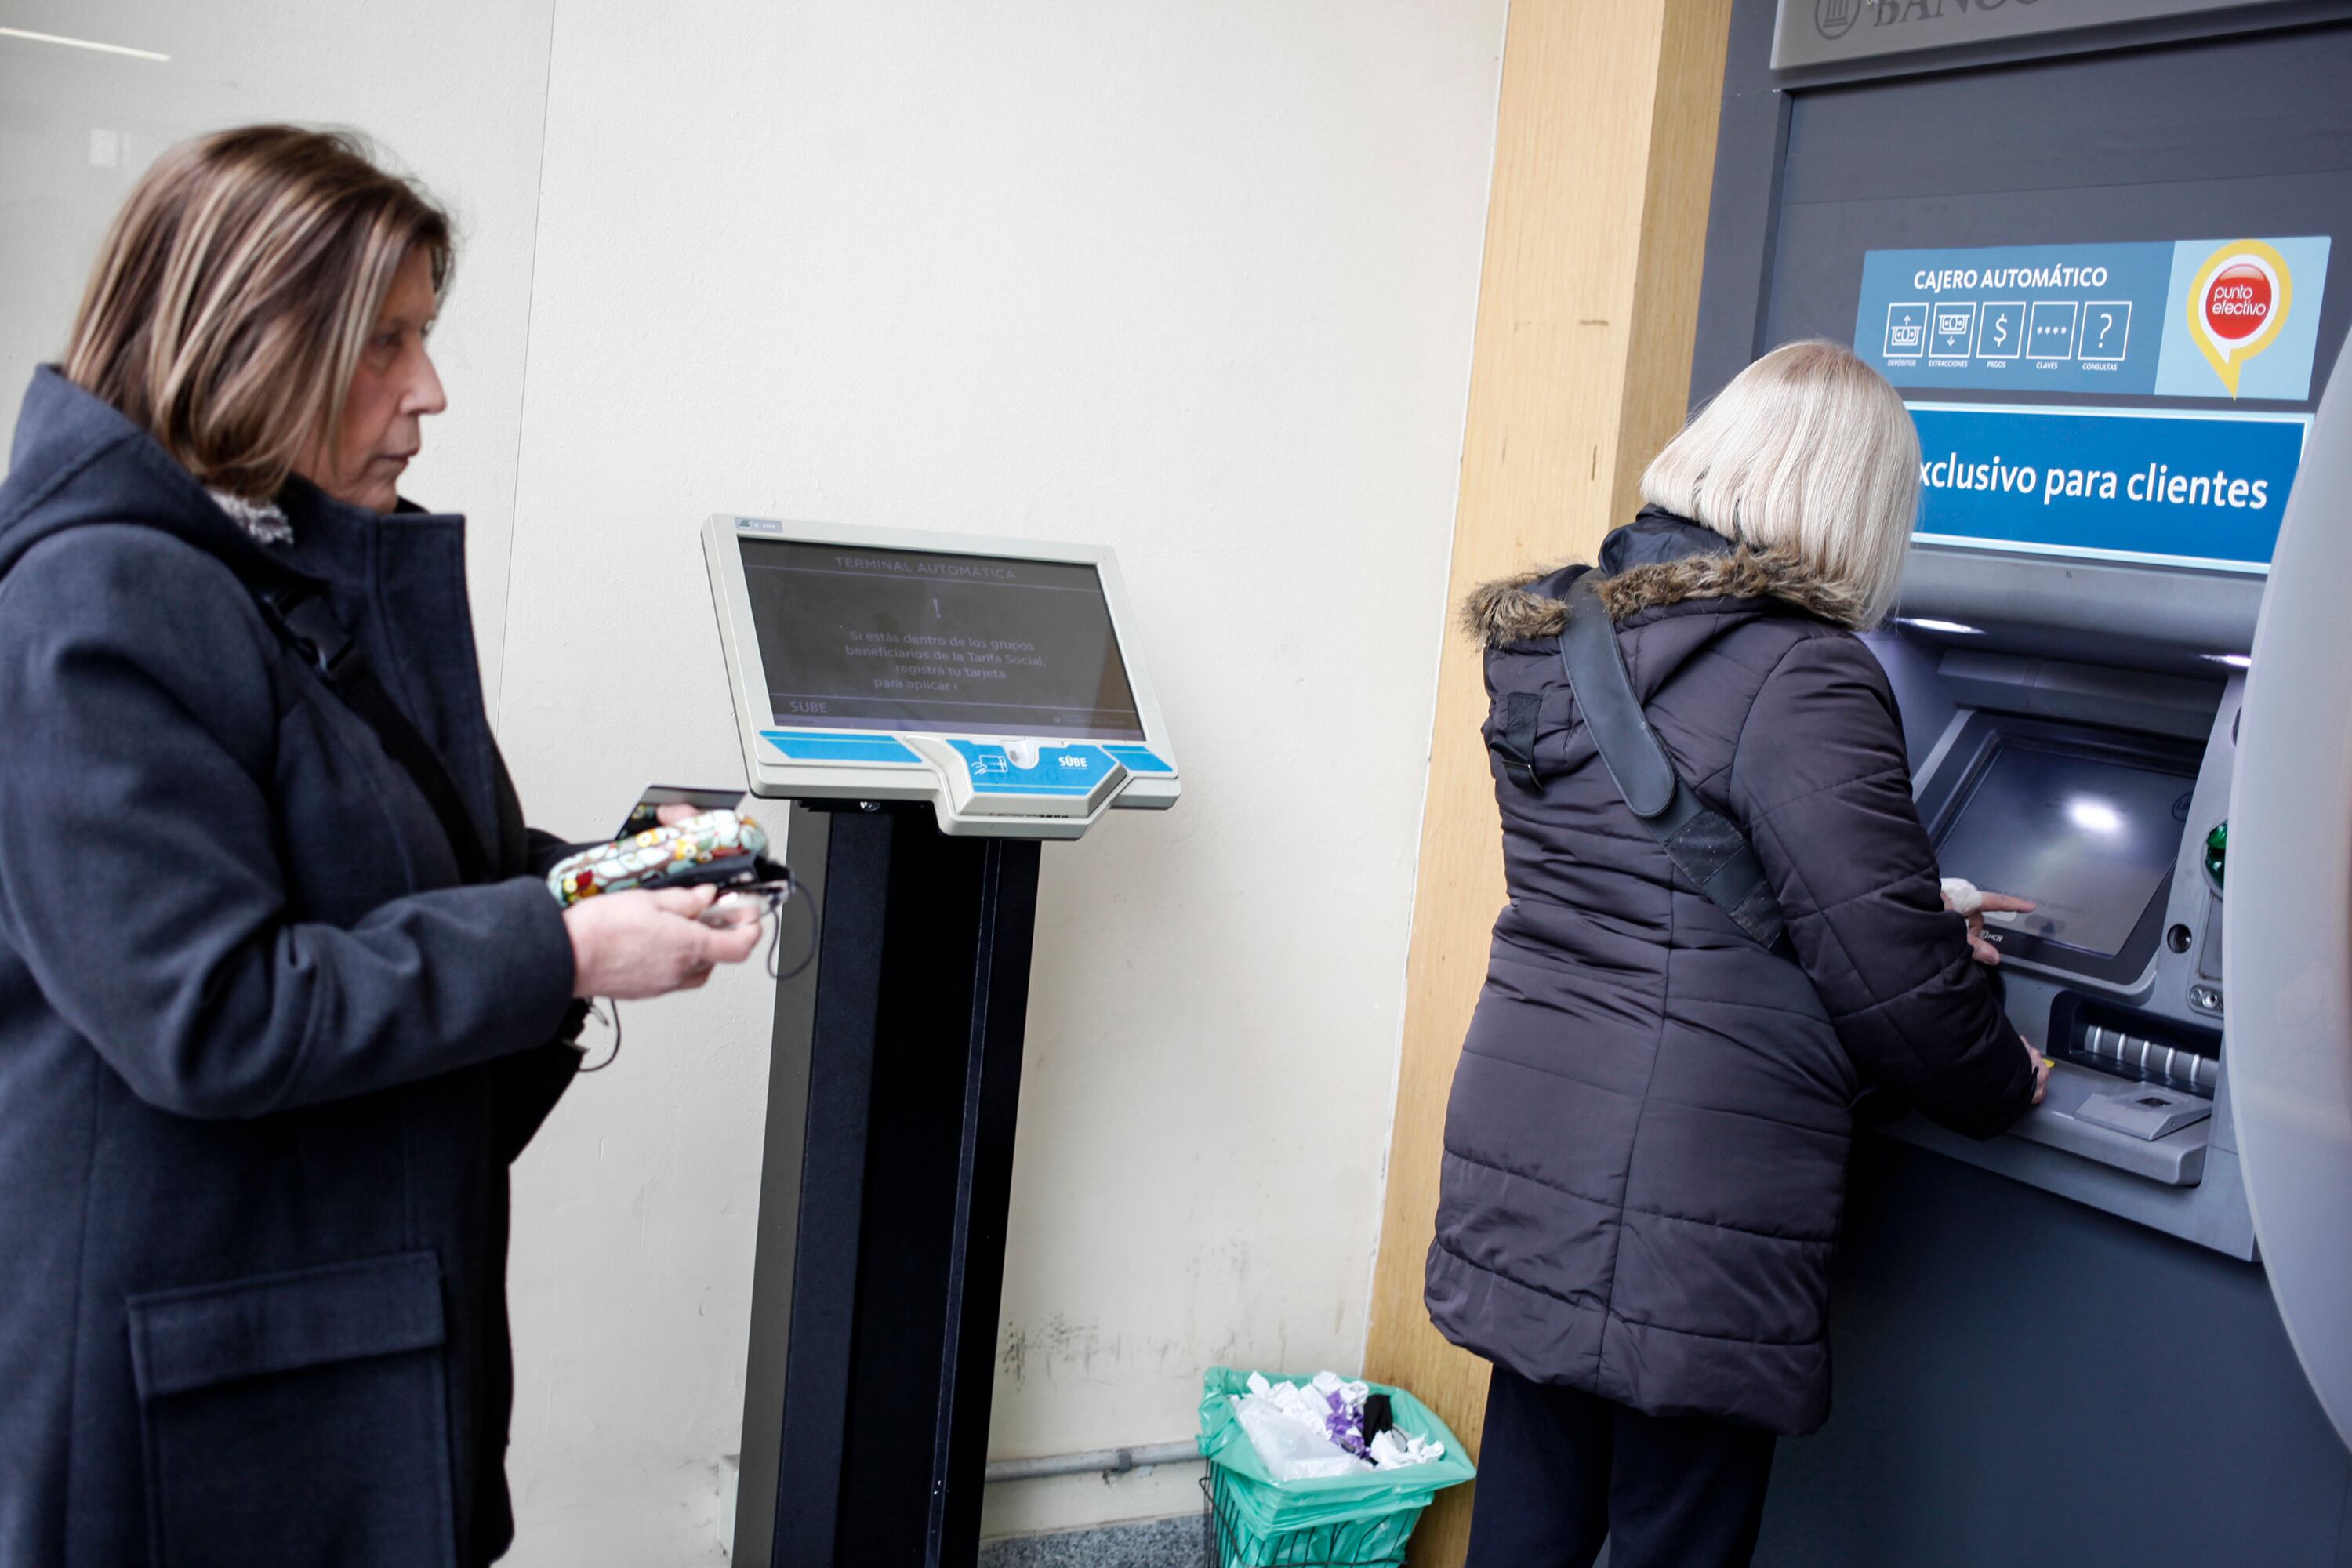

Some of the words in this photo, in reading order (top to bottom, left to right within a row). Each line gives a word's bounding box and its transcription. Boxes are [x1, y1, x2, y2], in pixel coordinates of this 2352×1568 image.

[1914, 270, 1978, 294] CAJERO
[1980, 263, 2108, 289] AUTOMÁTICO
[2213, 284, 2253, 302] punto
[2212, 298, 2267, 317] efectivo
[1928, 360, 1969, 368] EXTRACCIONES
[1987, 361, 2007, 369] PAGOS
[2035, 361, 2058, 370] CLAVES
[2082, 362, 2118, 372] CONSULTAS
[1919, 452, 2037, 494] xclusivo
[2044, 468, 2118, 505] para
[2126, 463, 2269, 510] clientes
[835, 557, 913, 573] TERMINAL
[916, 562, 1017, 580] AUTOMÁTICA
[849, 630, 862, 641] Si
[866, 631, 900, 644] estás
[903, 633, 946, 646] dentro
[949, 636, 965, 648] de
[969, 637, 988, 650] los
[990, 640, 1035, 654] grupos
[845, 645, 930, 660] beneficiarios
[933, 649, 949, 662] de
[953, 651, 964, 662] la
[969, 652, 1003, 665] Tarifa
[948, 666, 962, 677] tu
[964, 666, 1007, 681] tarjeta
[873, 677, 903, 690] para
[906, 678, 950, 691] aplicar
[789, 700, 828, 713] SUBE
[1058, 754, 1088, 768] SUBE
